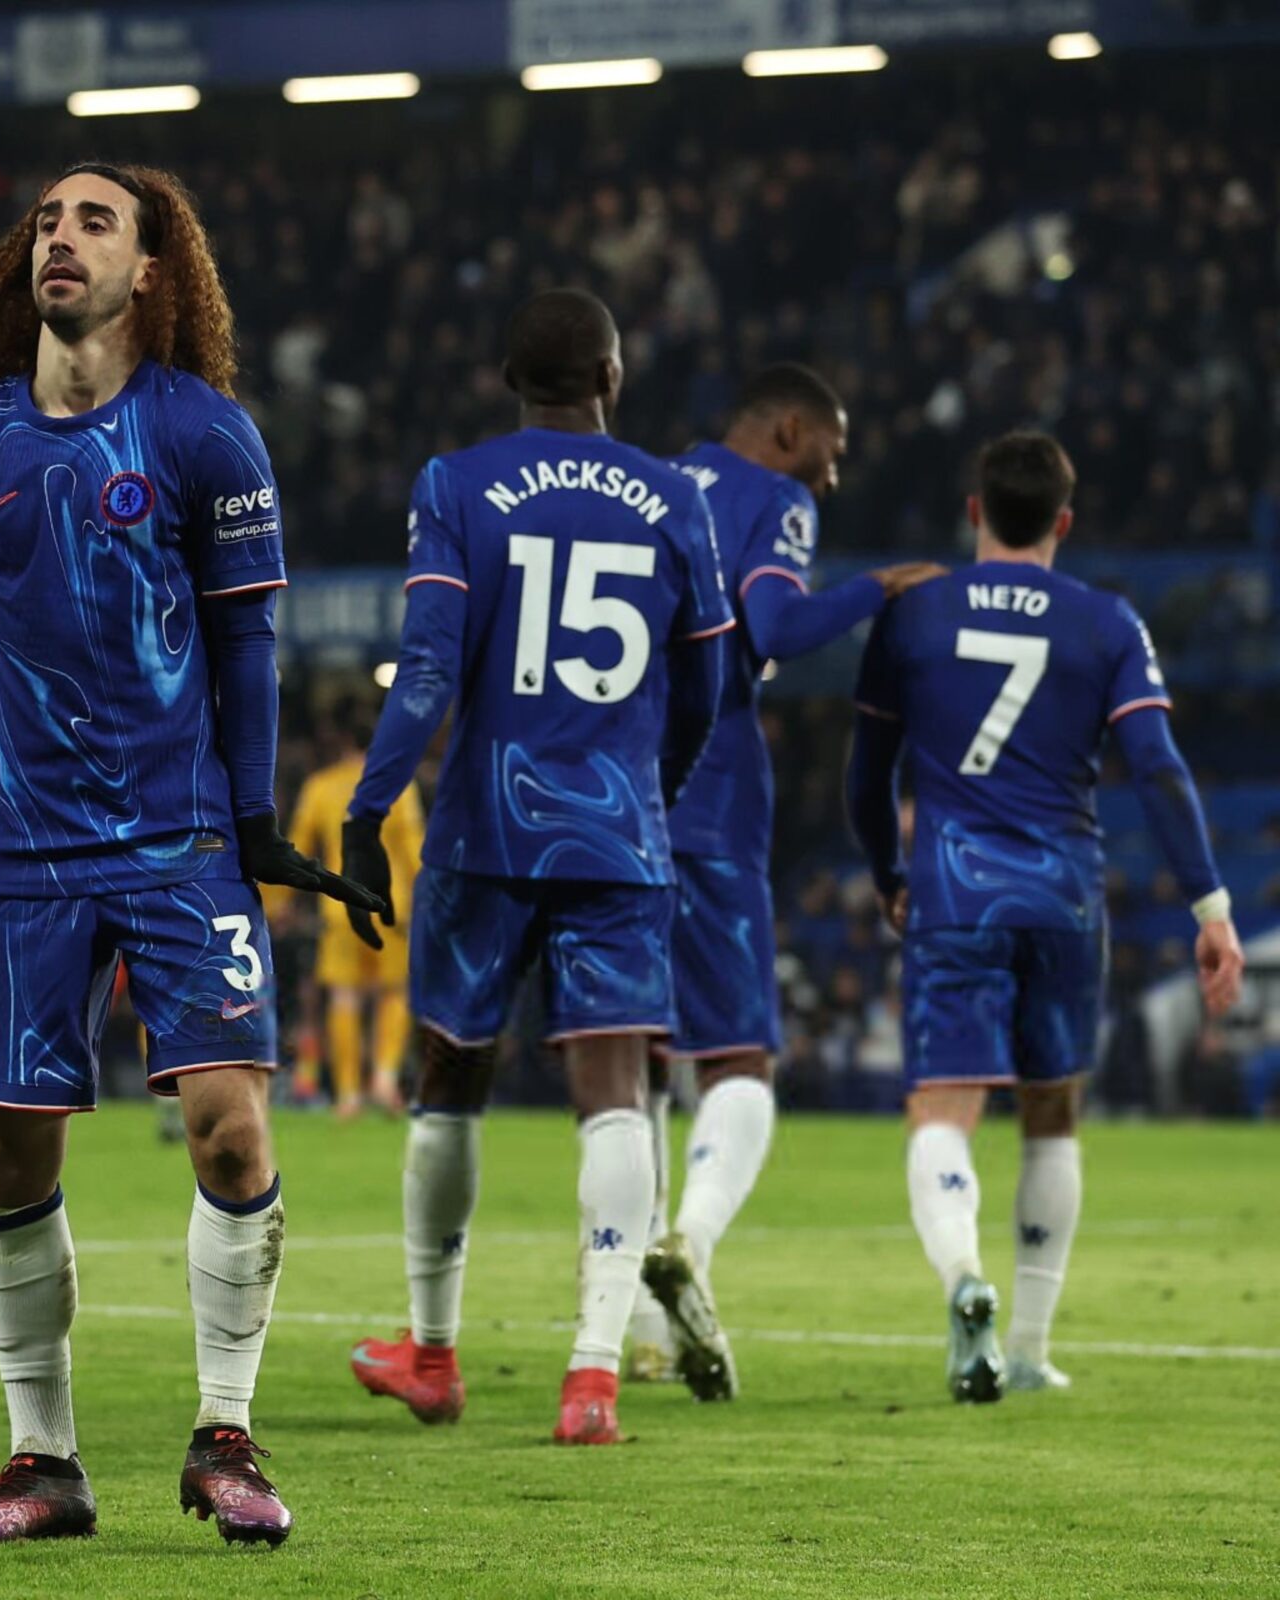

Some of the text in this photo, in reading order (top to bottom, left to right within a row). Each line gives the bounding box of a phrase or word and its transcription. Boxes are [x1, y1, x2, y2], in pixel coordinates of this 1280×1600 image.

[484, 459, 669, 525] N.JACKSON
[508, 533, 656, 704] 15
[967, 583, 1050, 617] NETO
[955, 627, 1050, 776] 7
[212, 914, 263, 991] 3
